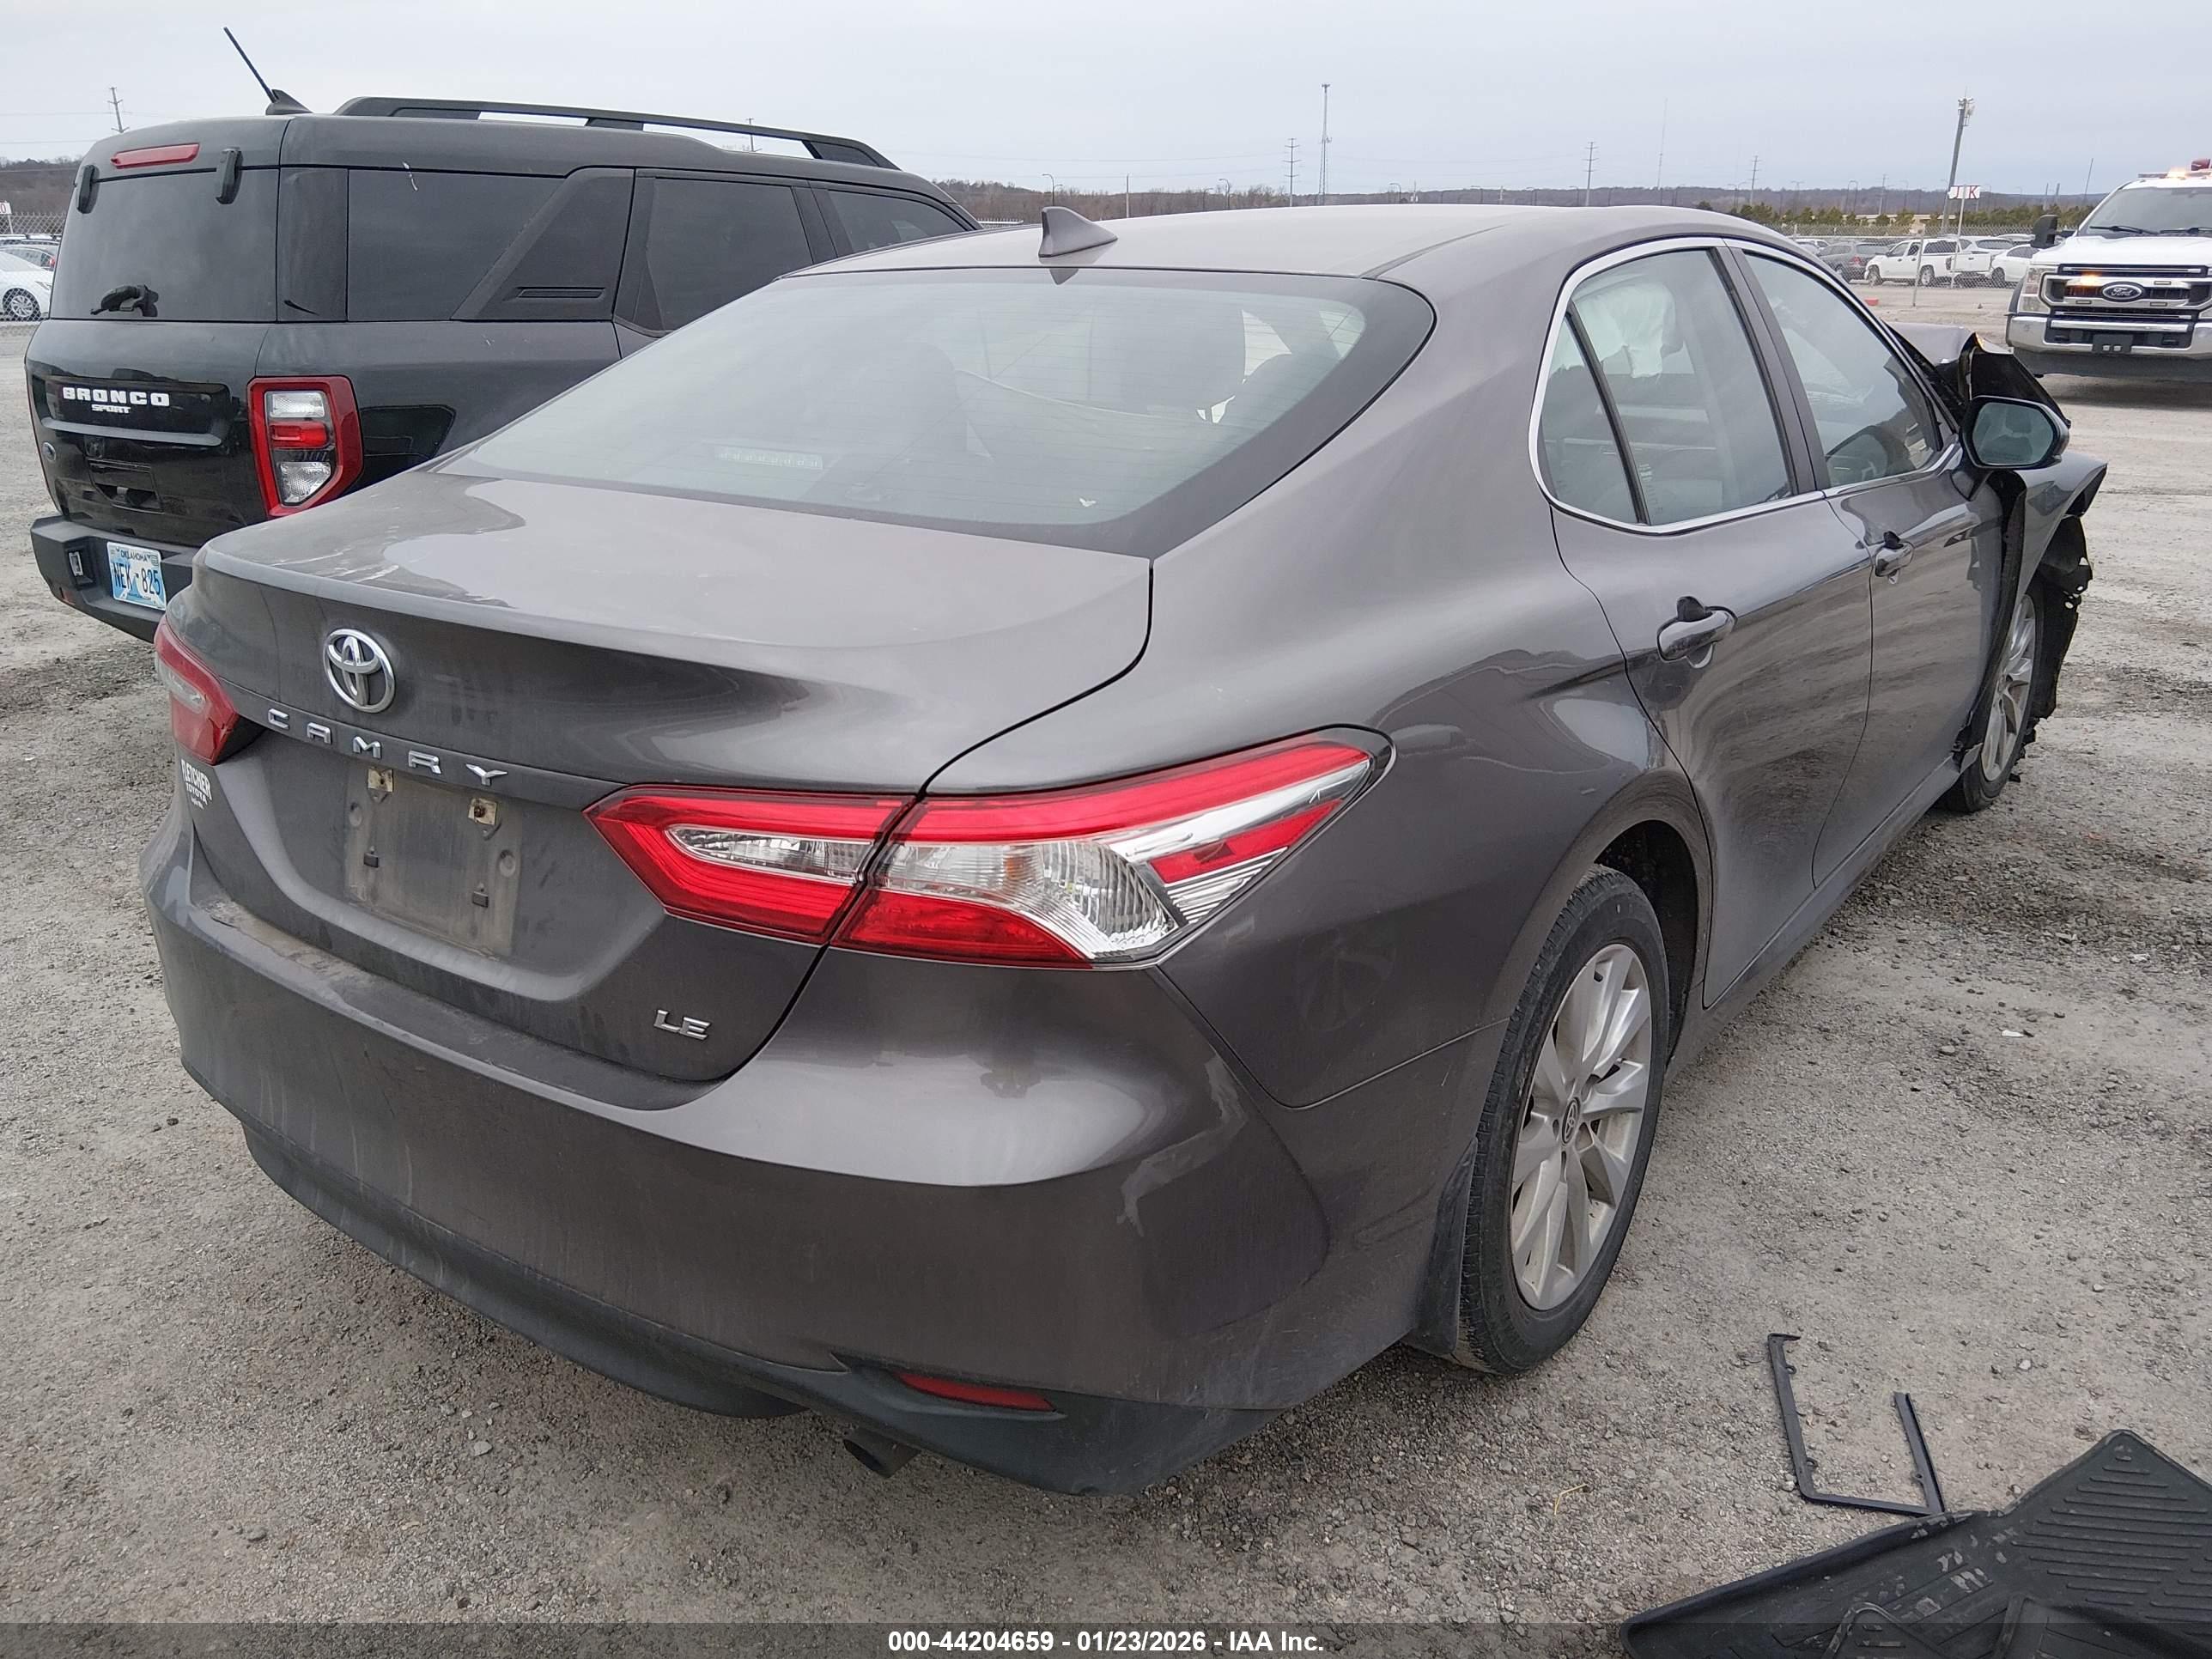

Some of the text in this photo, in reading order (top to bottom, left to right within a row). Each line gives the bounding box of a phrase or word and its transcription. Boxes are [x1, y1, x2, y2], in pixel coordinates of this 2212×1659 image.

[2111, 287, 2133, 296] Ford
[62, 386, 170, 407] BRONCO
[91, 404, 131, 414] SPORT
[120, 550, 148, 562] OKLAHOMA
[112, 562, 161, 595] NEK 825
[267, 708, 508, 787] CAMRY
[180, 758, 213, 801] FLETCHER
[185, 782, 208, 805] TOYOTA
[653, 1009, 712, 1041] LE
